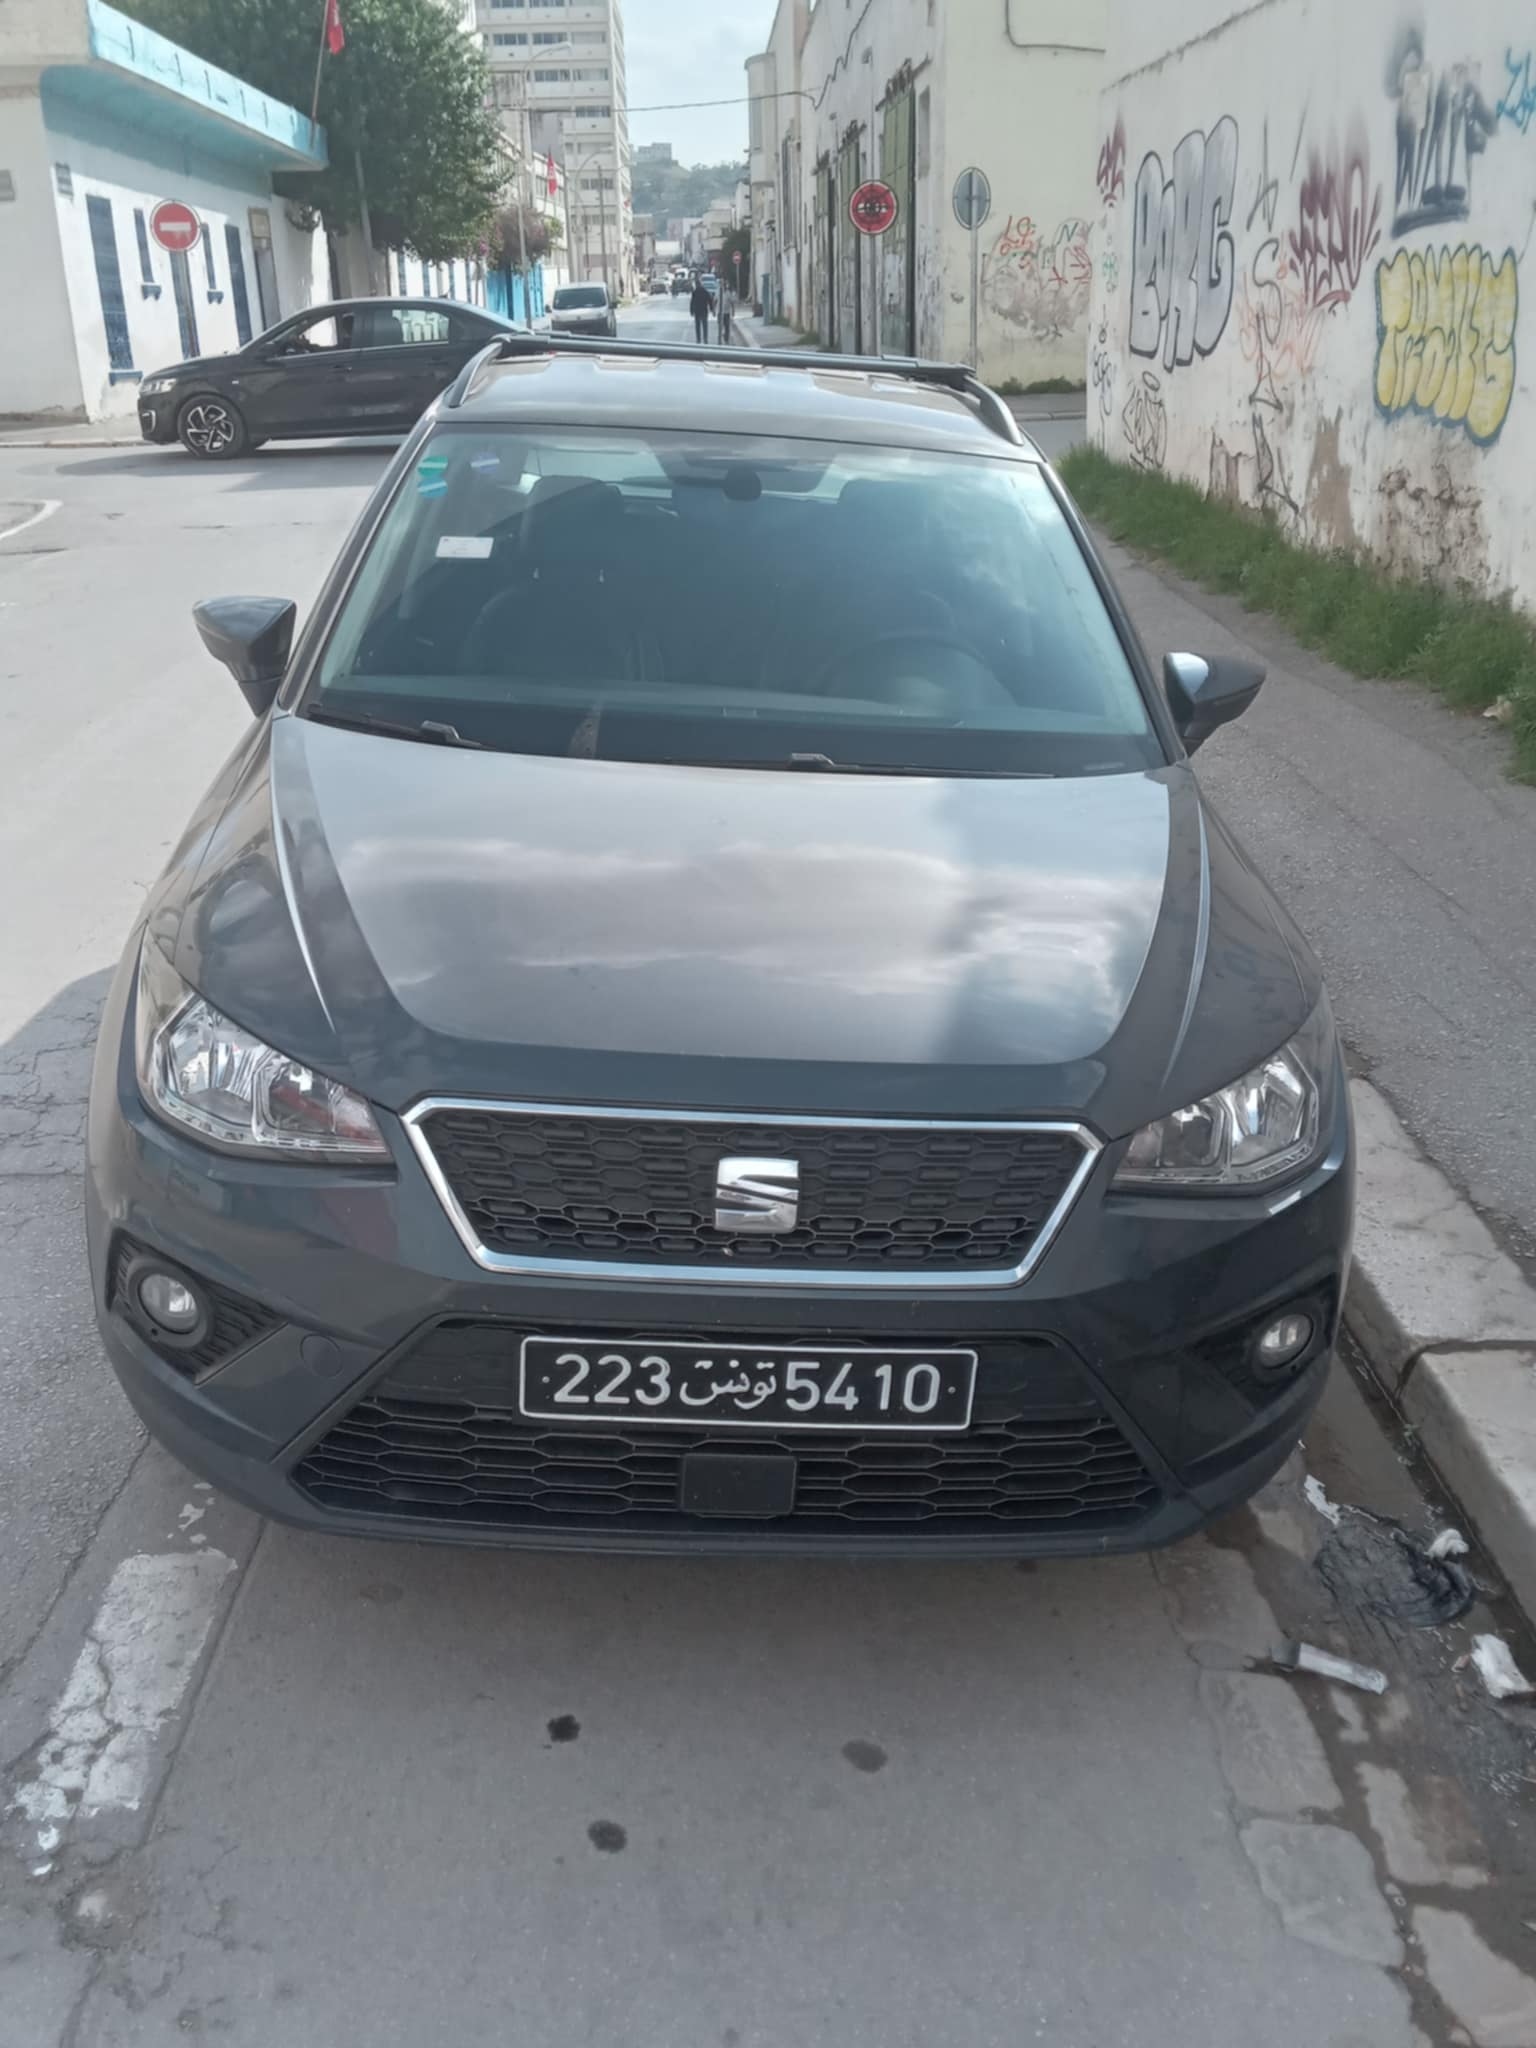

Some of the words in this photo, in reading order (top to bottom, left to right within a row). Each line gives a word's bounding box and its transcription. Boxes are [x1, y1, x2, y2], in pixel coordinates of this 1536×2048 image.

[553, 1353, 671, 1405] 223
[679, 1359, 777, 1409] تونس
[785, 1361, 942, 1413] 5410
